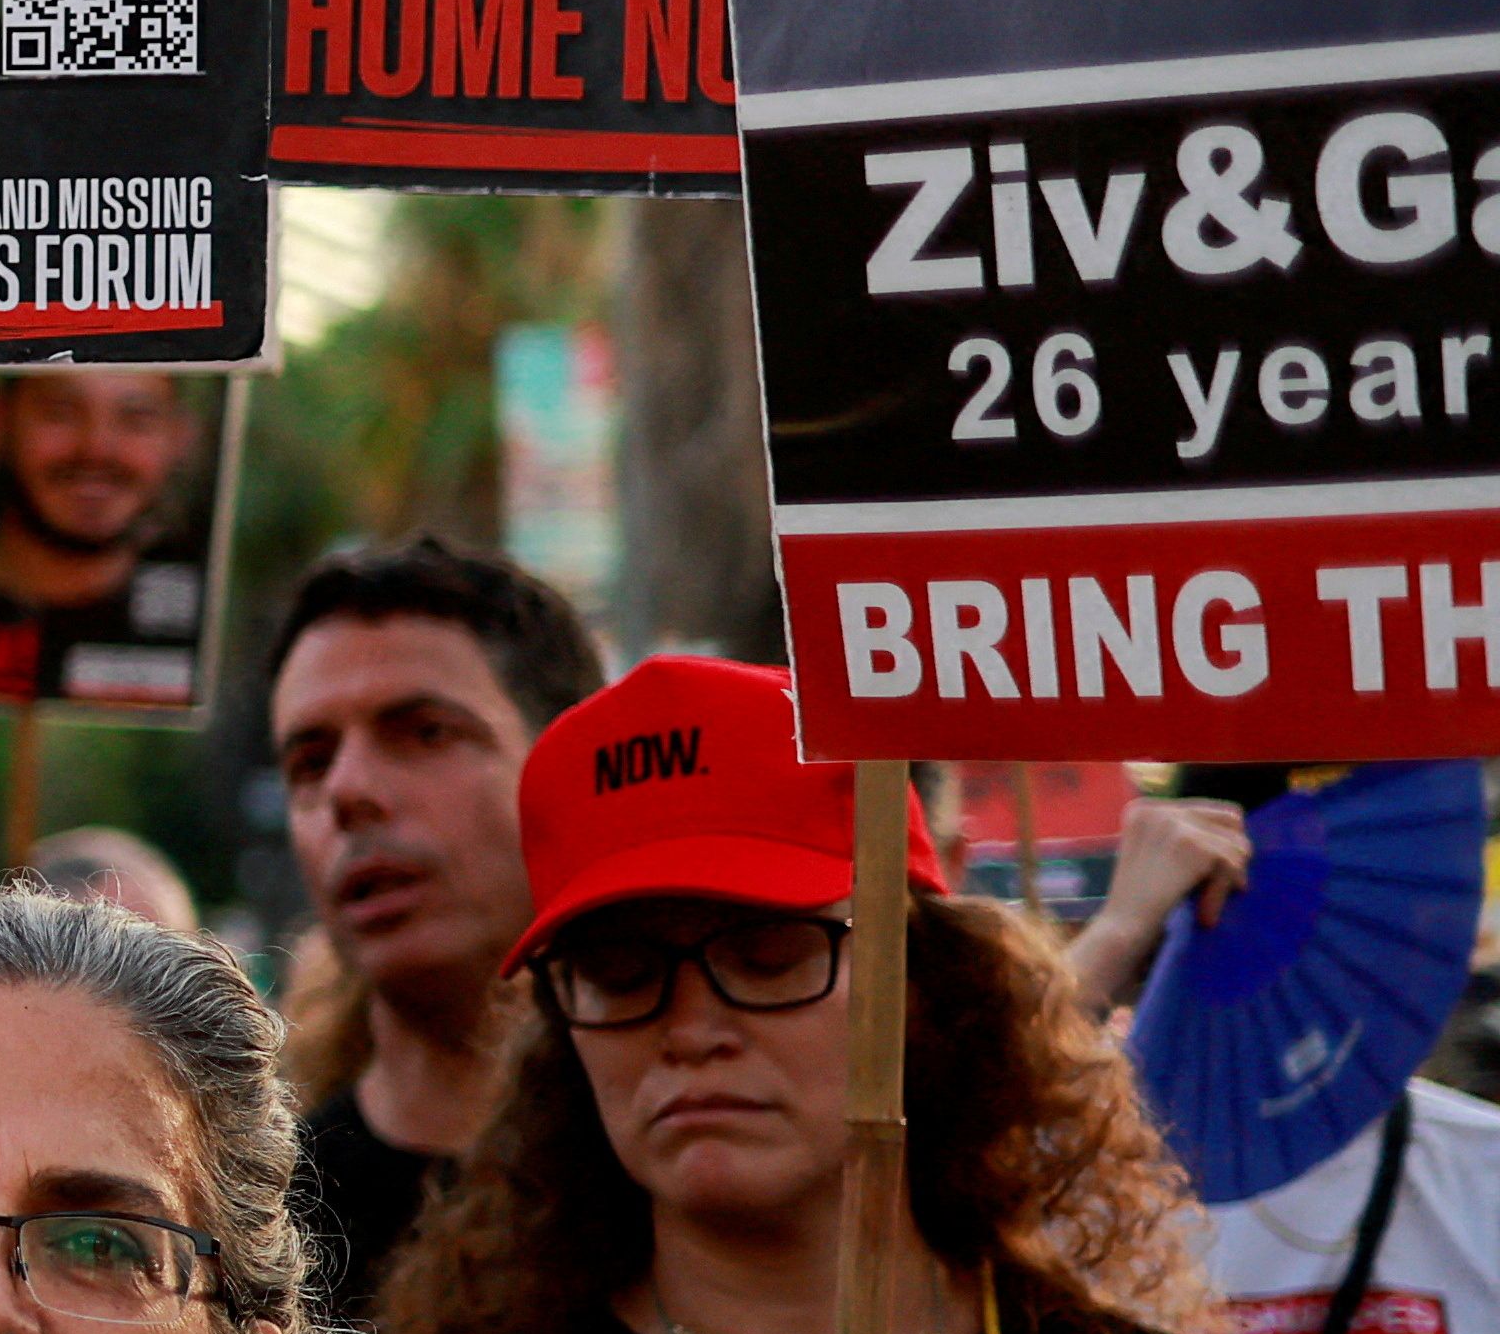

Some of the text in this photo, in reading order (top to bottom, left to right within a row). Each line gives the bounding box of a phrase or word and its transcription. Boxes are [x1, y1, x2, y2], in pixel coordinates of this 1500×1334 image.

[56, 176, 213, 230] MISSING
[33, 234, 213, 311] FORUM
[947, 331, 1101, 442] 26
[837, 569, 1270, 702] BRING
[592, 724, 710, 795] NOW.
